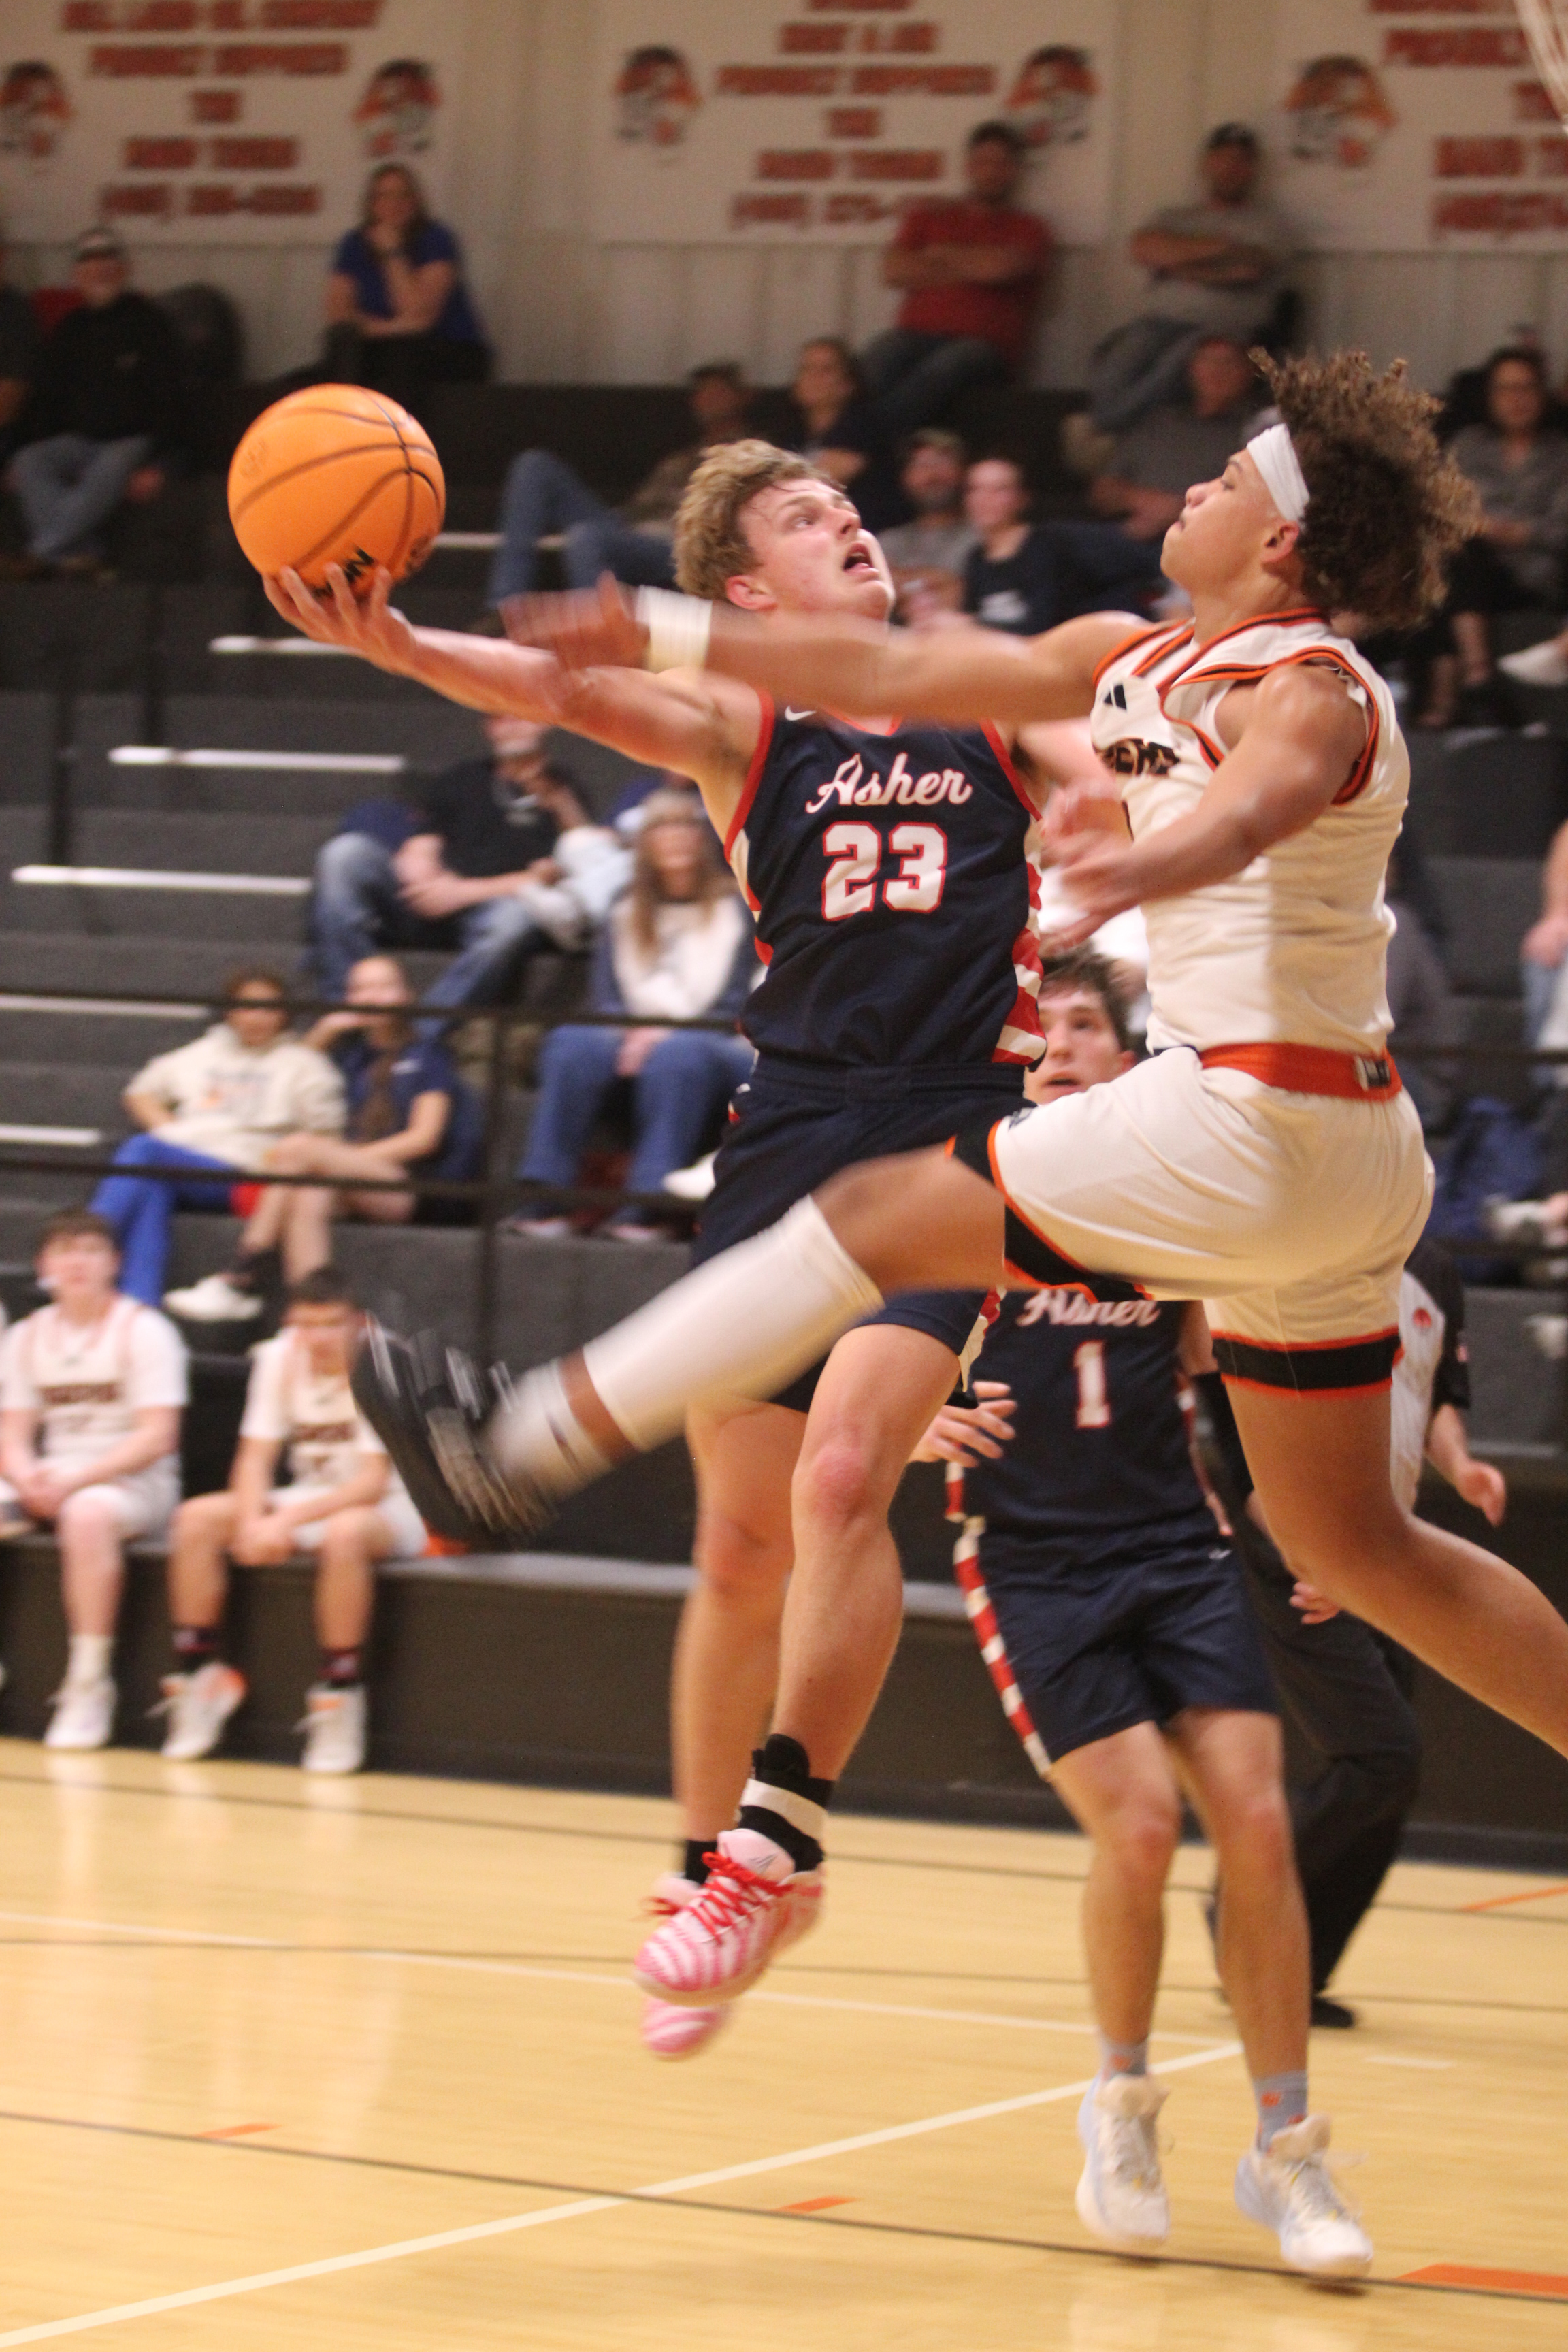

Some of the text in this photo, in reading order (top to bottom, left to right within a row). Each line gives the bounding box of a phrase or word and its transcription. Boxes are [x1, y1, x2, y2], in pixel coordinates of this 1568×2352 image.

[805, 752, 973, 813] Asher
[821, 821, 948, 922] 23
[1073, 1339, 1112, 1429] 1
